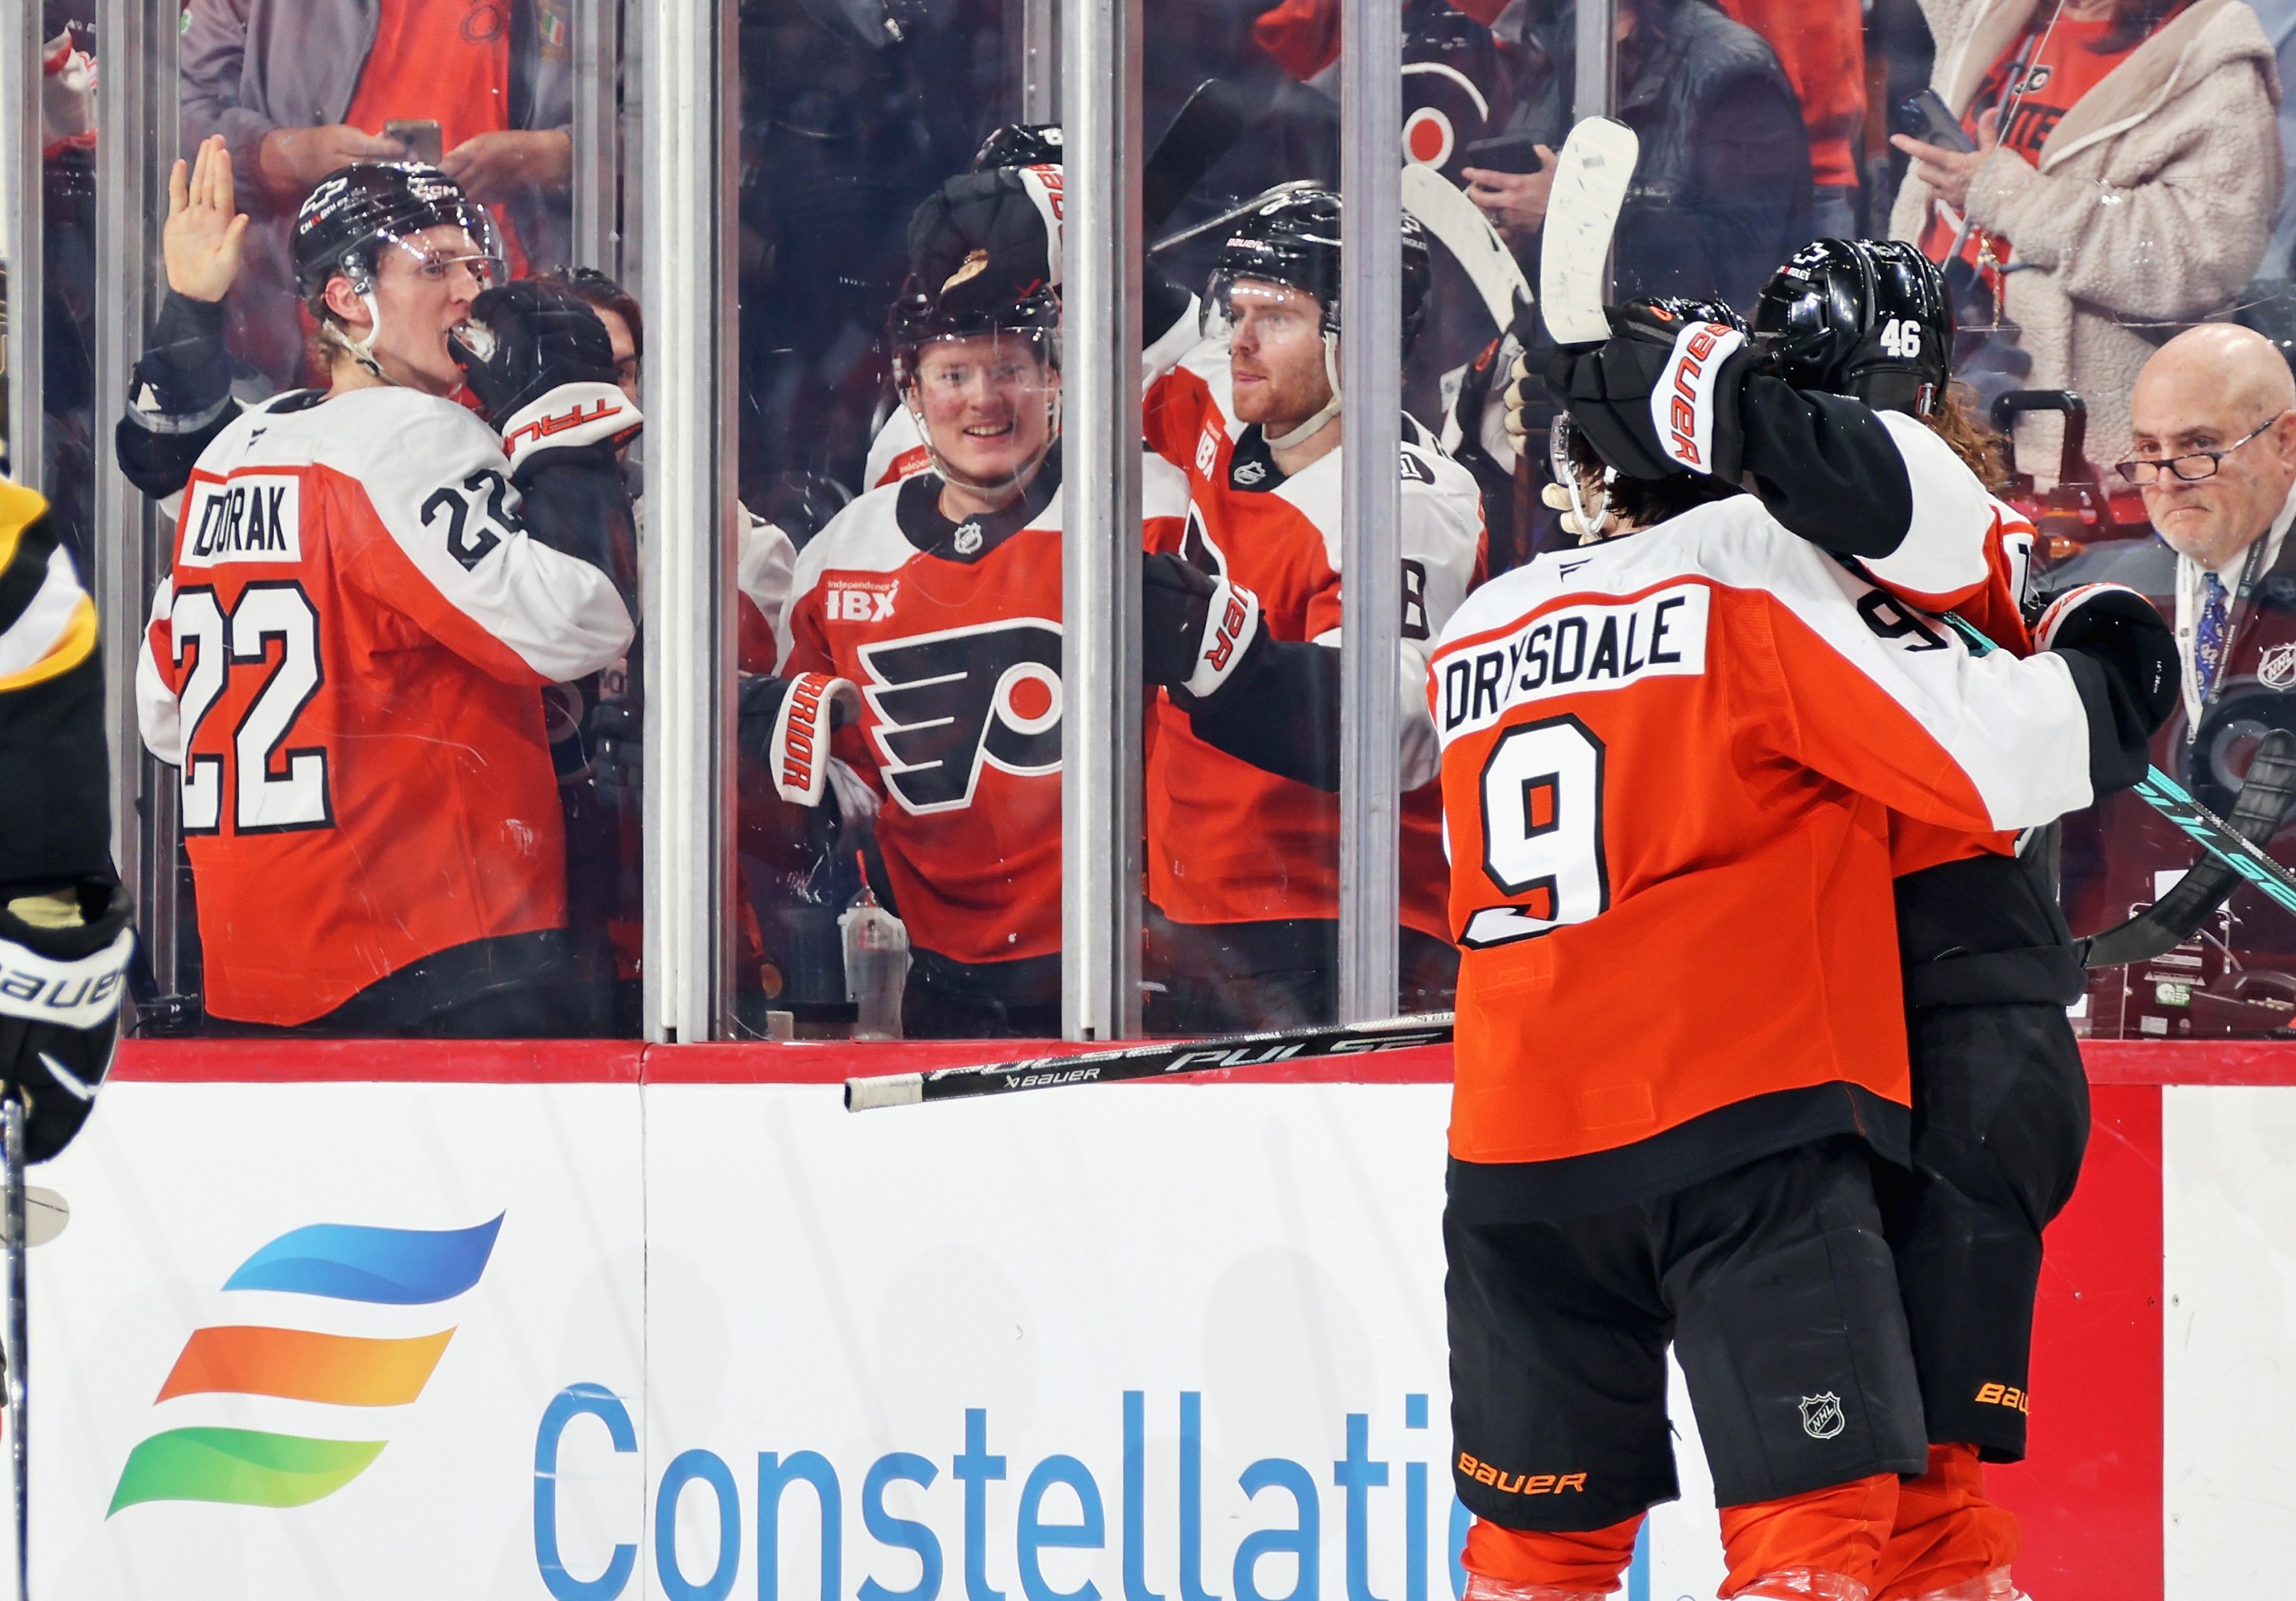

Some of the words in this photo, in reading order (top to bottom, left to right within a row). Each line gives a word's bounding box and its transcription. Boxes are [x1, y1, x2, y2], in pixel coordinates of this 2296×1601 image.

[1880, 319, 1921, 357] 46
[420, 469, 524, 572] 22
[826, 588, 898, 623] IBX
[1205, 580, 1248, 672] UER
[171, 580, 336, 836] 22
[1445, 595, 1685, 732] DRYSDALE
[1456, 713, 1610, 950] 9
[1020, 1068, 1101, 1088] BAUER
[1458, 1451, 1587, 1496] BAUER
